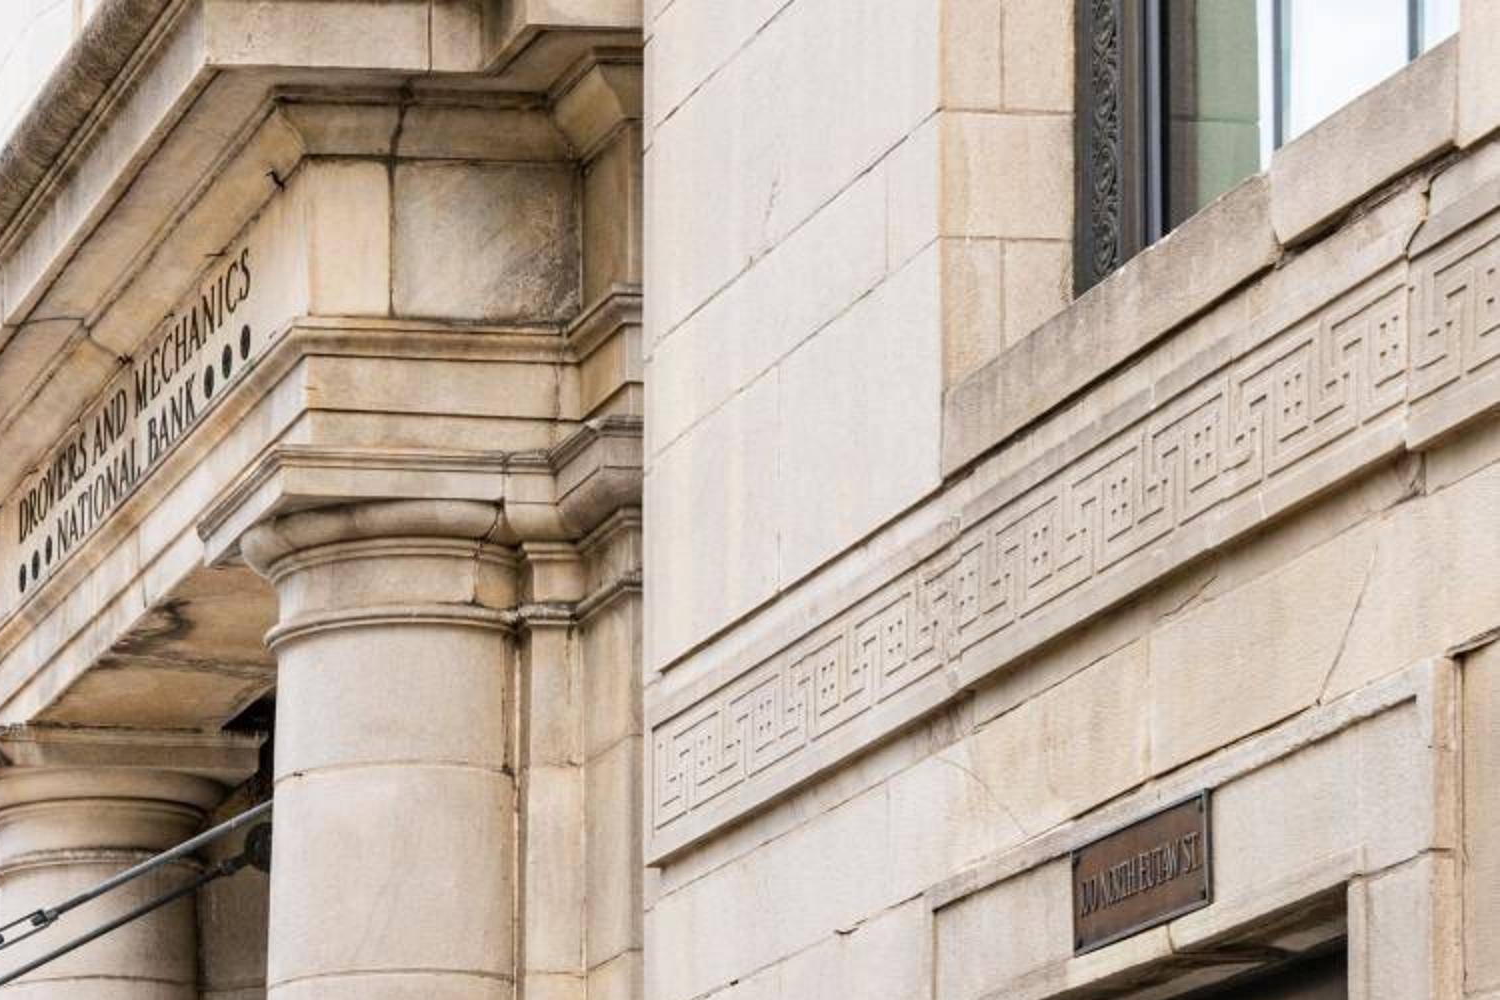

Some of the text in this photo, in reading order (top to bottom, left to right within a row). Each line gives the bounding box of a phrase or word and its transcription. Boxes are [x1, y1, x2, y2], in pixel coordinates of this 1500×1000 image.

[19, 247, 251, 544] DROVERS AND MECHANICS
[57, 373, 196, 560] NATIONAL BANK
